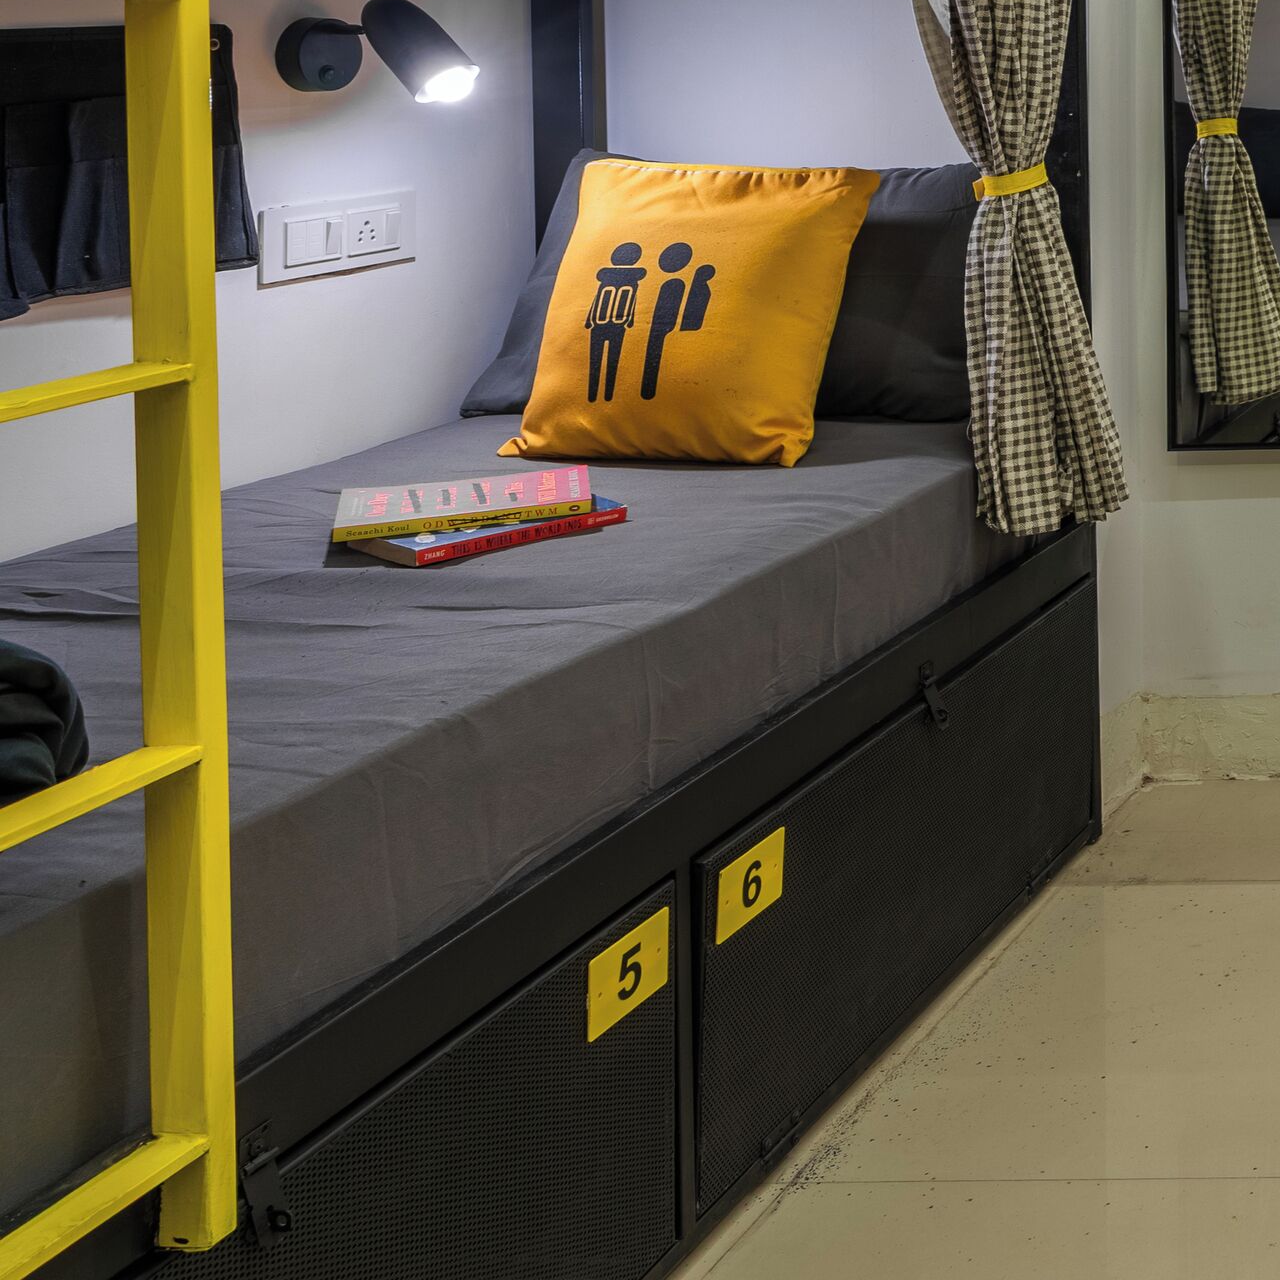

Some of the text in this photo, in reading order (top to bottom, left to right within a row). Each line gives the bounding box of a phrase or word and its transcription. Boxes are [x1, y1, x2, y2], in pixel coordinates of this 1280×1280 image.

[423, 549, 447, 560] ZHANG
[452, 542, 470, 556] THIS
[487, 533, 513, 549] WHERE
[518, 528, 530, 541] THE
[534, 523, 561, 537] WORLD
[564, 519, 582, 531] ENDS
[742, 860, 762, 908] 6
[617, 942, 642, 1001] 5
